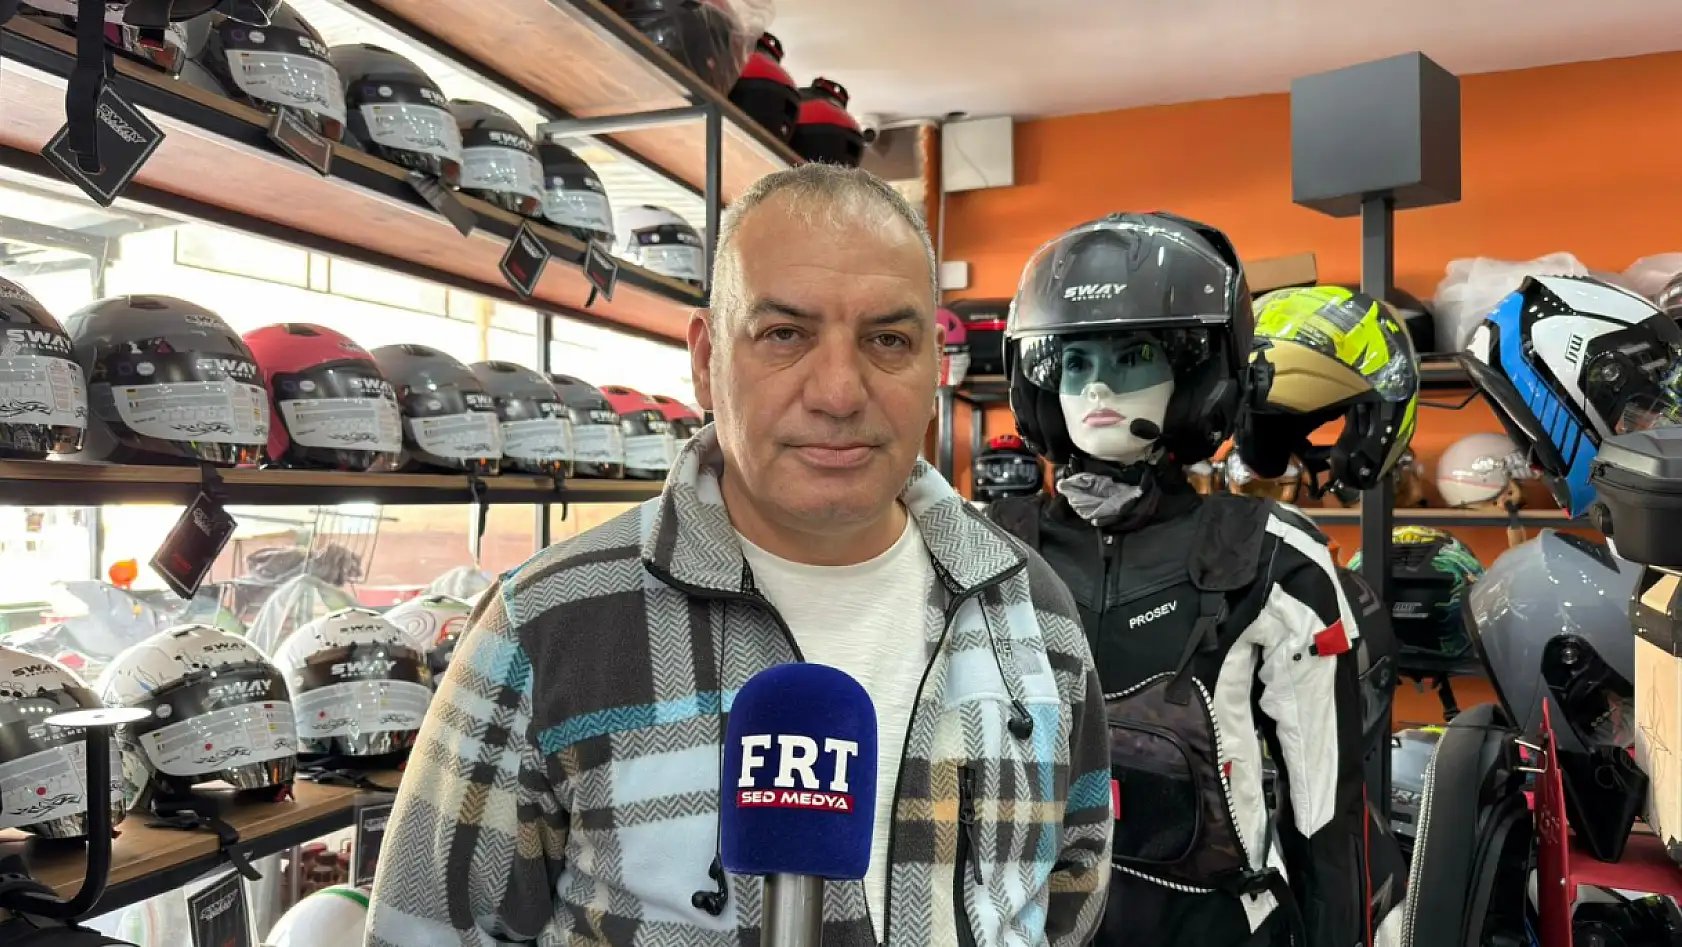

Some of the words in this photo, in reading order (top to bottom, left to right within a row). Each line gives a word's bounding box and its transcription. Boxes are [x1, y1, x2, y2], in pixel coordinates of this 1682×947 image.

[100, 103, 147, 142] SWAY
[1064, 284, 1127, 298] SWAY
[7, 329, 72, 352] SWAY
[196, 358, 257, 375] SWAY
[1129, 600, 1177, 629] PROSEV
[208, 678, 272, 697] SWAY
[738, 734, 859, 792] FRT
[741, 791, 776, 804] SED
[779, 793, 849, 811] MEDYA
